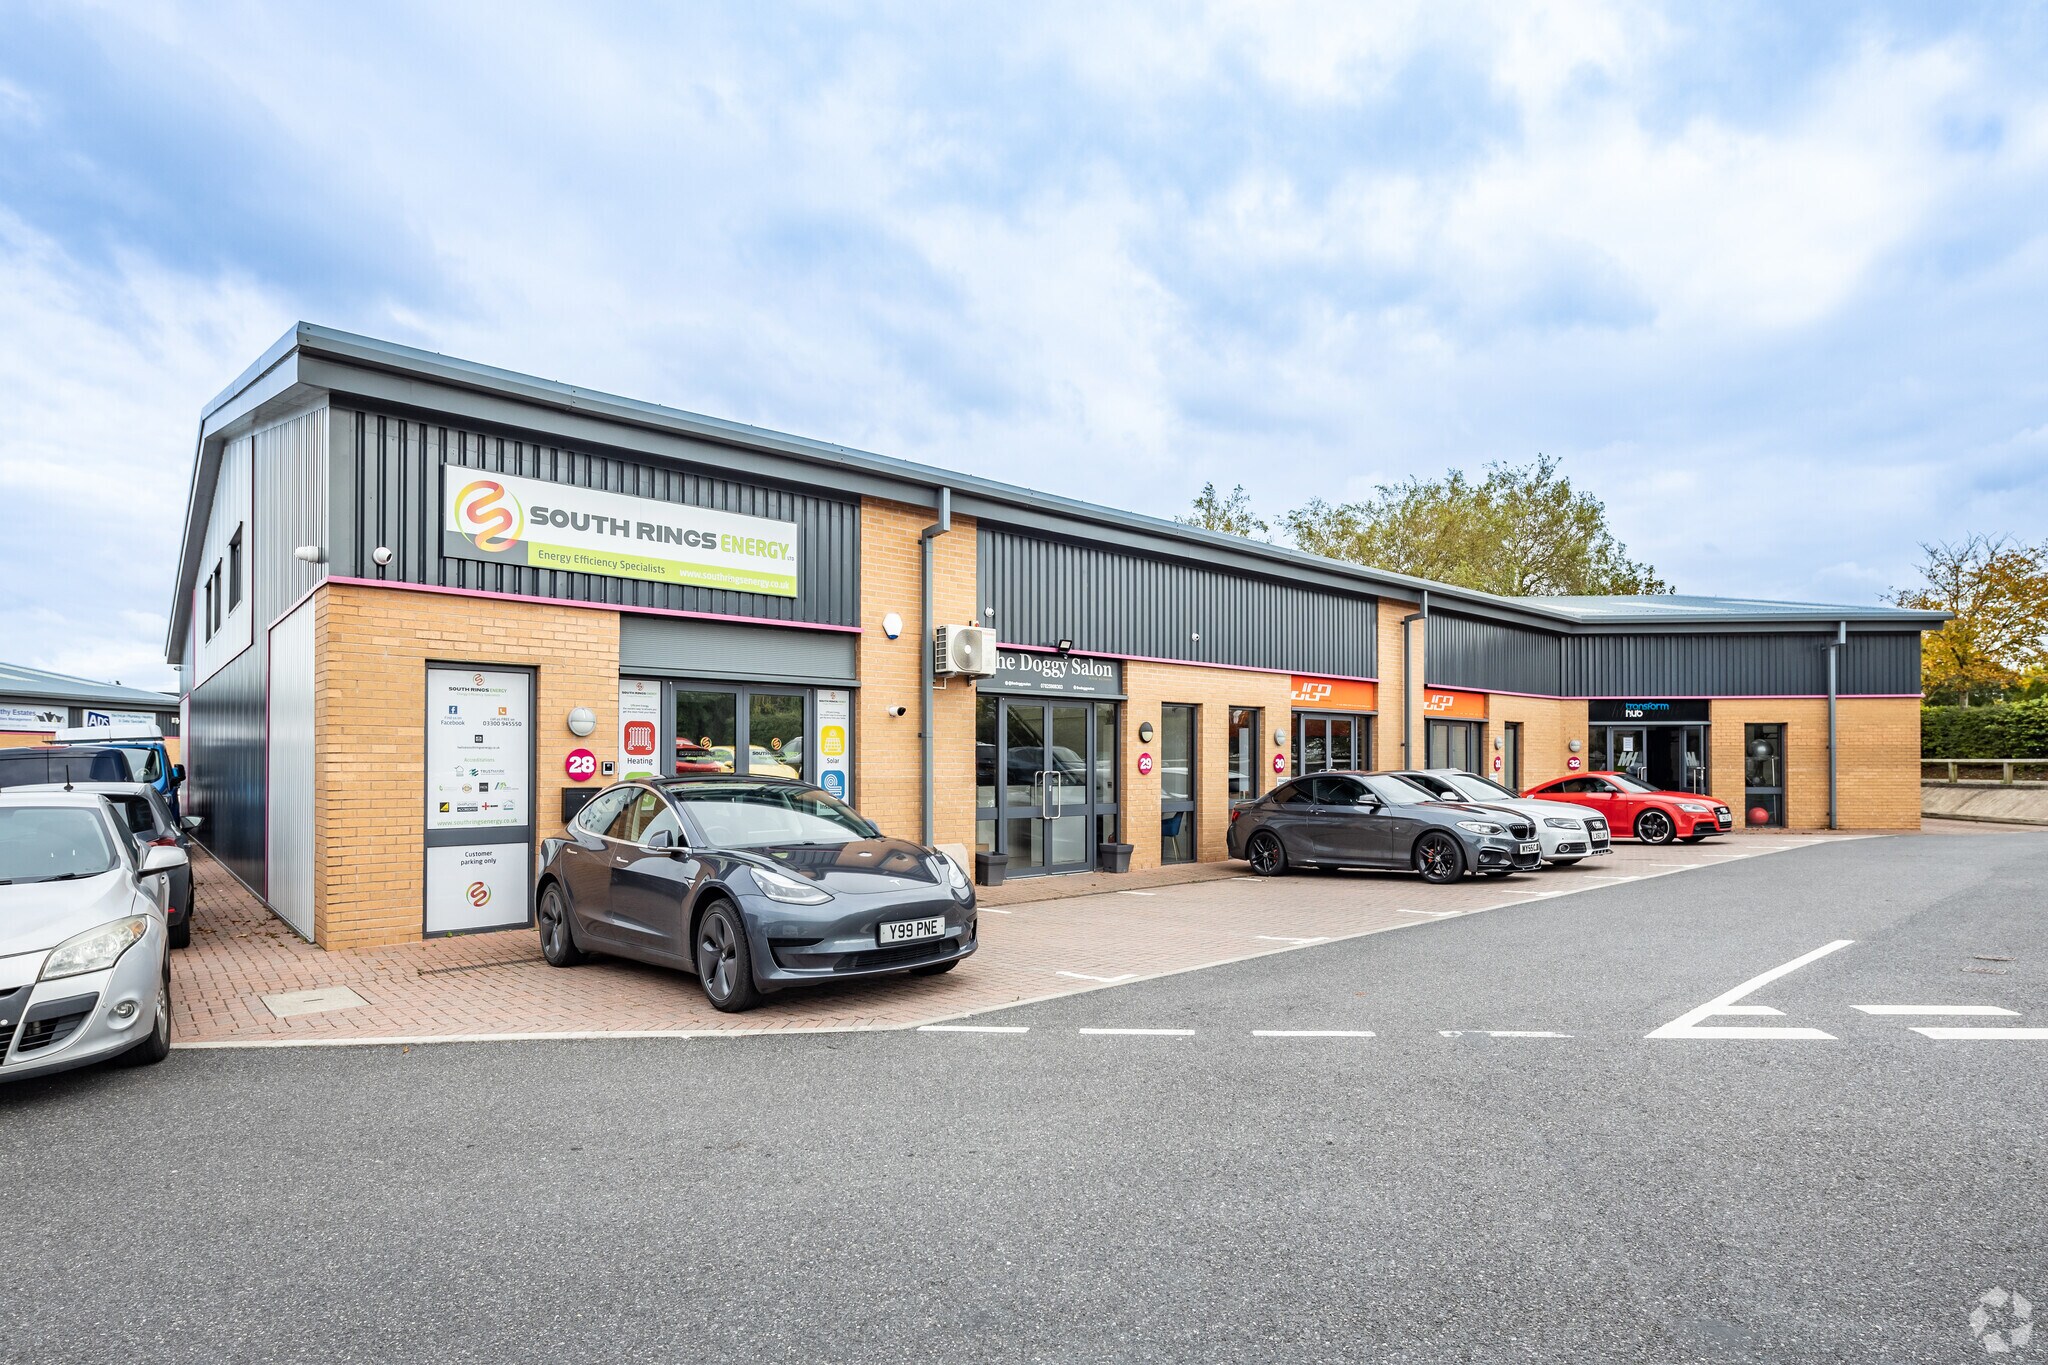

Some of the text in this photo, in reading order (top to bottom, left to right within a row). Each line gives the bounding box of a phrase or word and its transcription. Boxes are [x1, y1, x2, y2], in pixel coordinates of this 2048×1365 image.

[530, 506, 630, 538] SOUTH
[637, 521, 717, 550] RINGS
[721, 534, 789, 560] ENERGY
[538, 550, 665, 574] Energy Efficiency Specialists
[680, 569, 790, 590] www.southringsenergy.co.uk
[996, 649, 1112, 678] he Doggy Salon
[1625, 702, 1670, 710] transform
[1625, 709, 1644, 718] hub
[89, 714, 110, 727] ADS
[569, 756, 595, 773] 28
[627, 757, 653, 766] Heating
[1140, 758, 1152, 769] 29
[1275, 758, 1285, 769] 30
[1569, 759, 1580, 768] 32
[437, 818, 518, 827] www.southringsenergy.co.uk
[461, 858, 483, 866] parking
[890, 920, 937, 939] Y99 PNE
